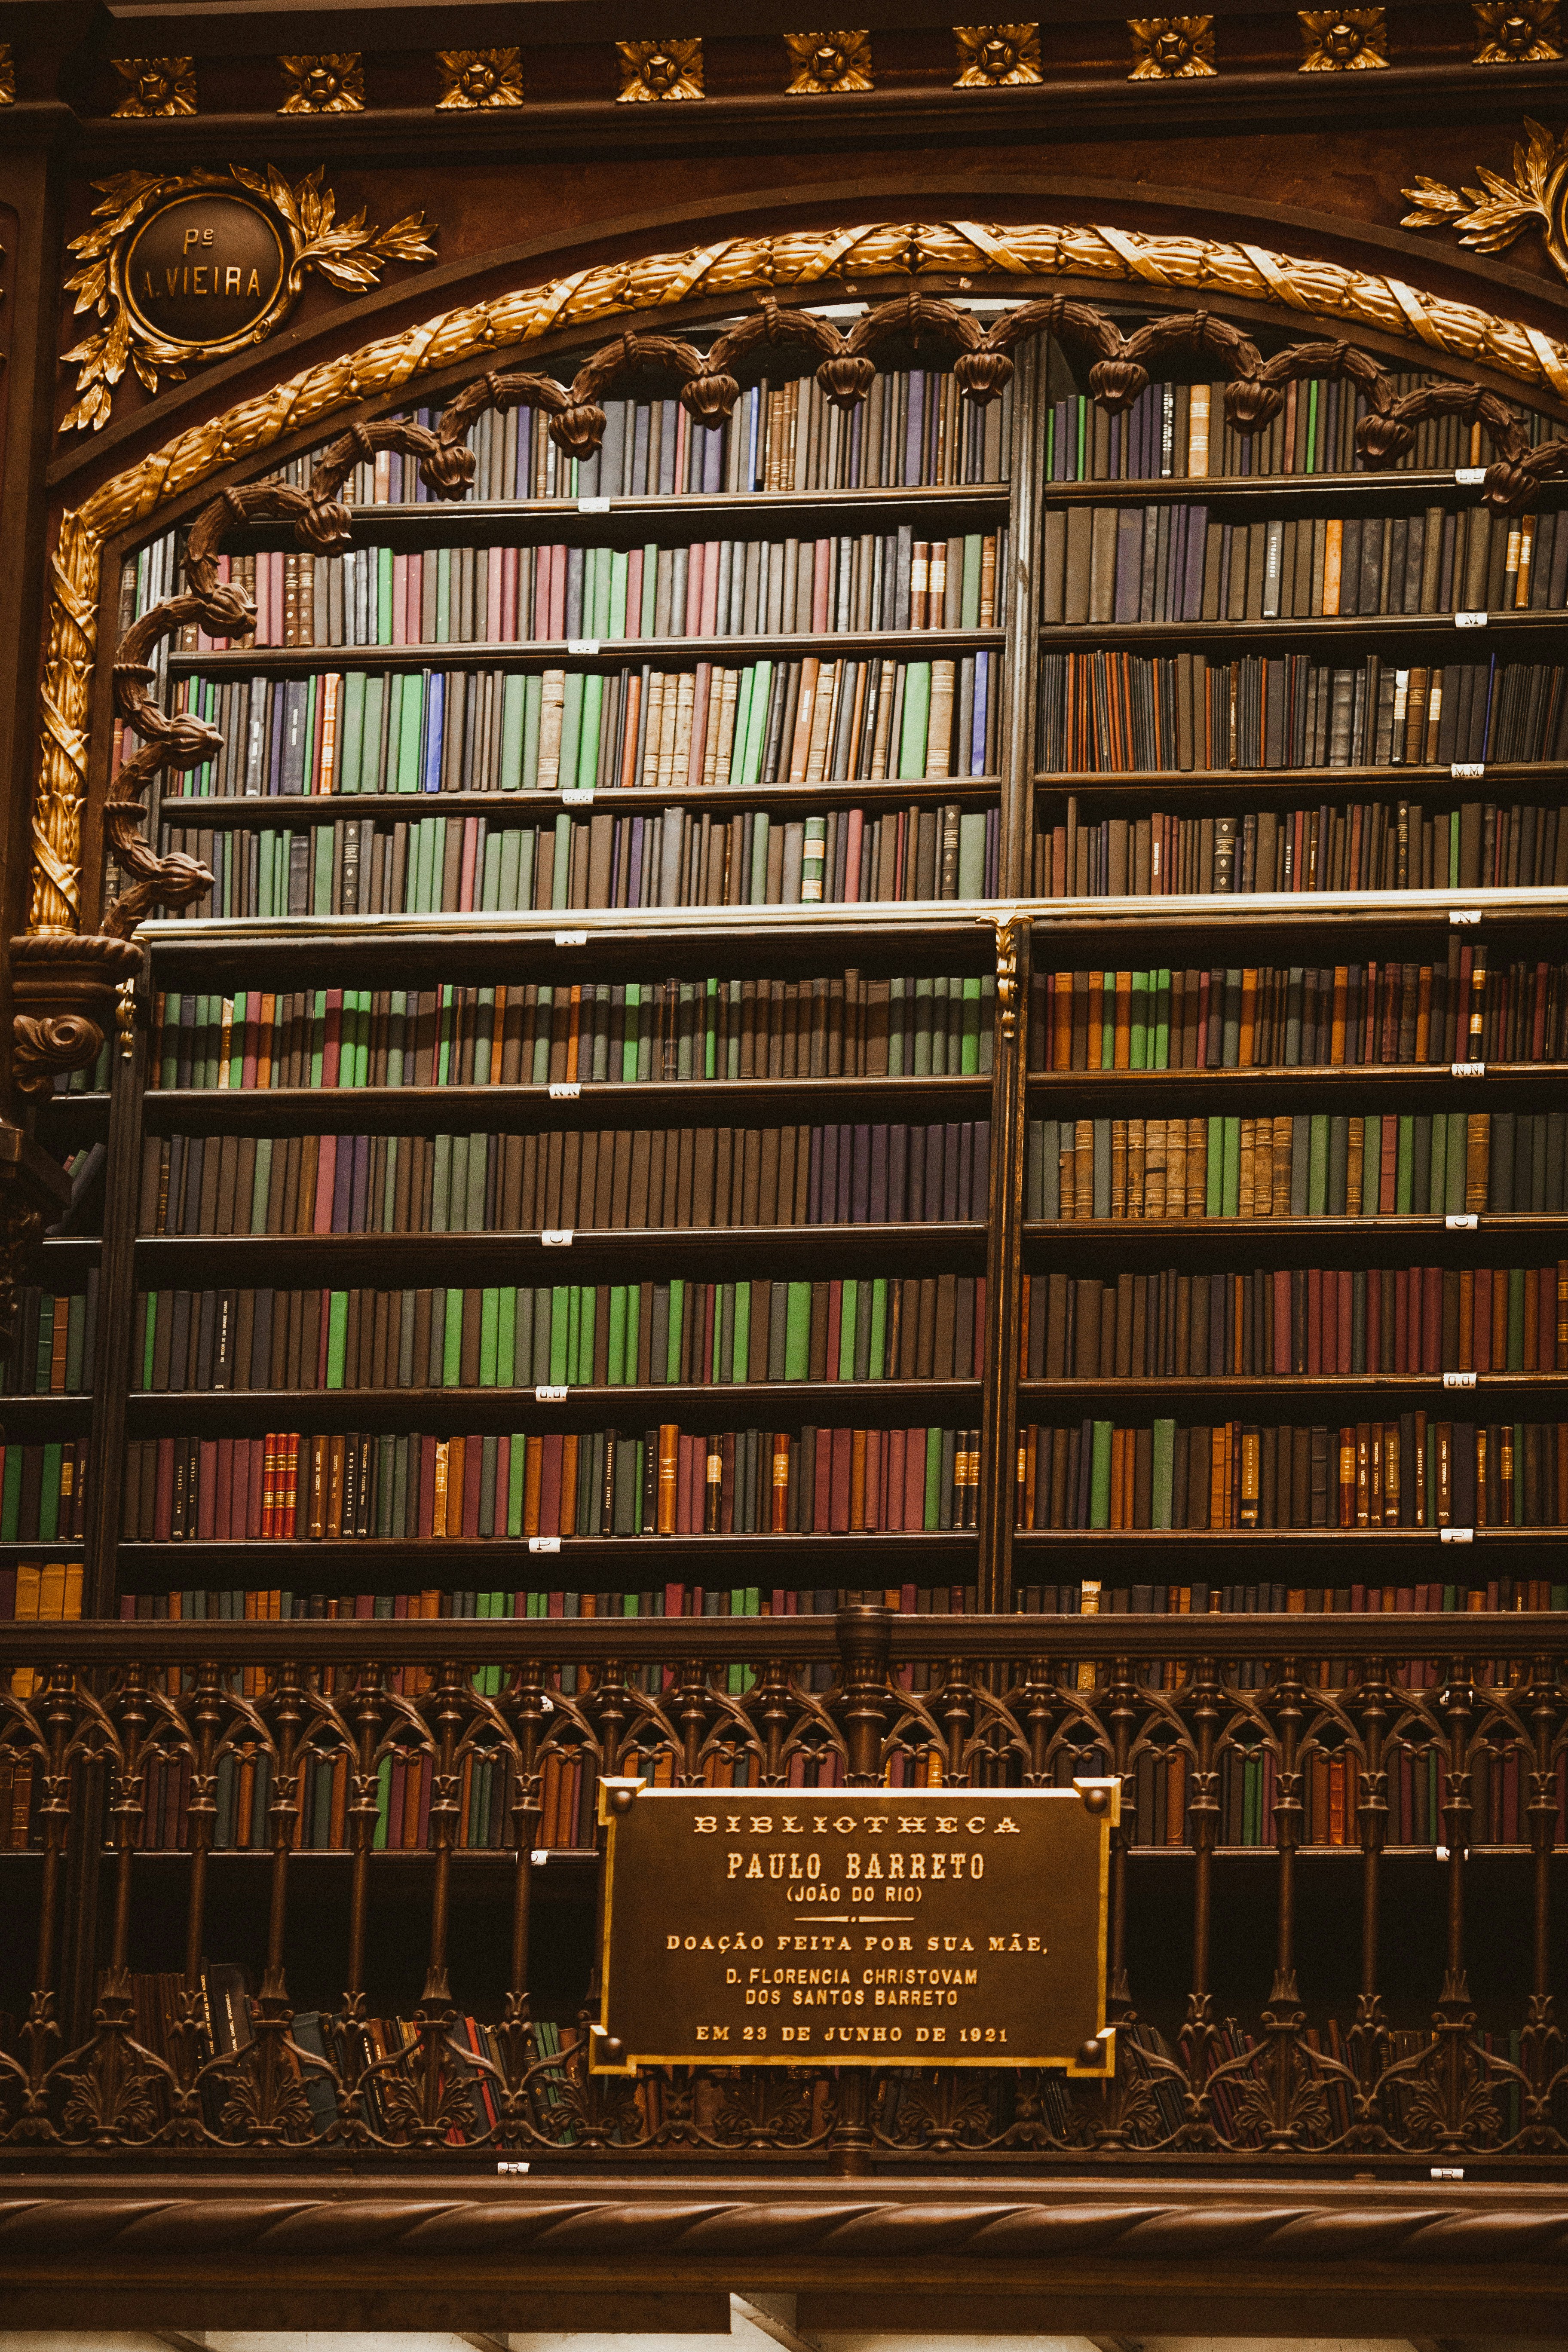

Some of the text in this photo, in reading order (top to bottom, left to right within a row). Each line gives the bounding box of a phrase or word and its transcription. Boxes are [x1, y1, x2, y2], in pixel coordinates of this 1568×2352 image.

[167, 266, 261, 297] VIEIRA
[1464, 615, 1479, 625] M
[1455, 766, 1483, 777] M.M.
[1458, 913, 1472, 924] N
[1455, 1065, 1482, 1075] N.N.
[1455, 1216, 1469, 1226] O
[550, 1233, 564, 1243] O
[648, 1485, 652, 1494] LA
[190, 1494, 194, 1503] OS
[1449, 1531, 1464, 1542] P
[537, 1540, 551, 1551] P
[694, 1815, 1020, 1834] BIBLIOTHECA
[727, 1853, 984, 1880] PAULO BARRETO
[787, 1883, 922, 1902] (JOÃO DO RIO)
[667, 1931, 1047, 1954] DOAÇÃO FEITA POR SUA MÃE,
[726, 1968, 977, 1985] D. FLORENCIA CHRISTOVAM
[745, 1989, 957, 2006] DOS SANTOS BARRETO
[696, 2026, 1007, 2042] EM 23 DE JUNHO DE 1921
[506, 2162, 520, 2174] R
[1440, 2169, 1454, 2180] R
